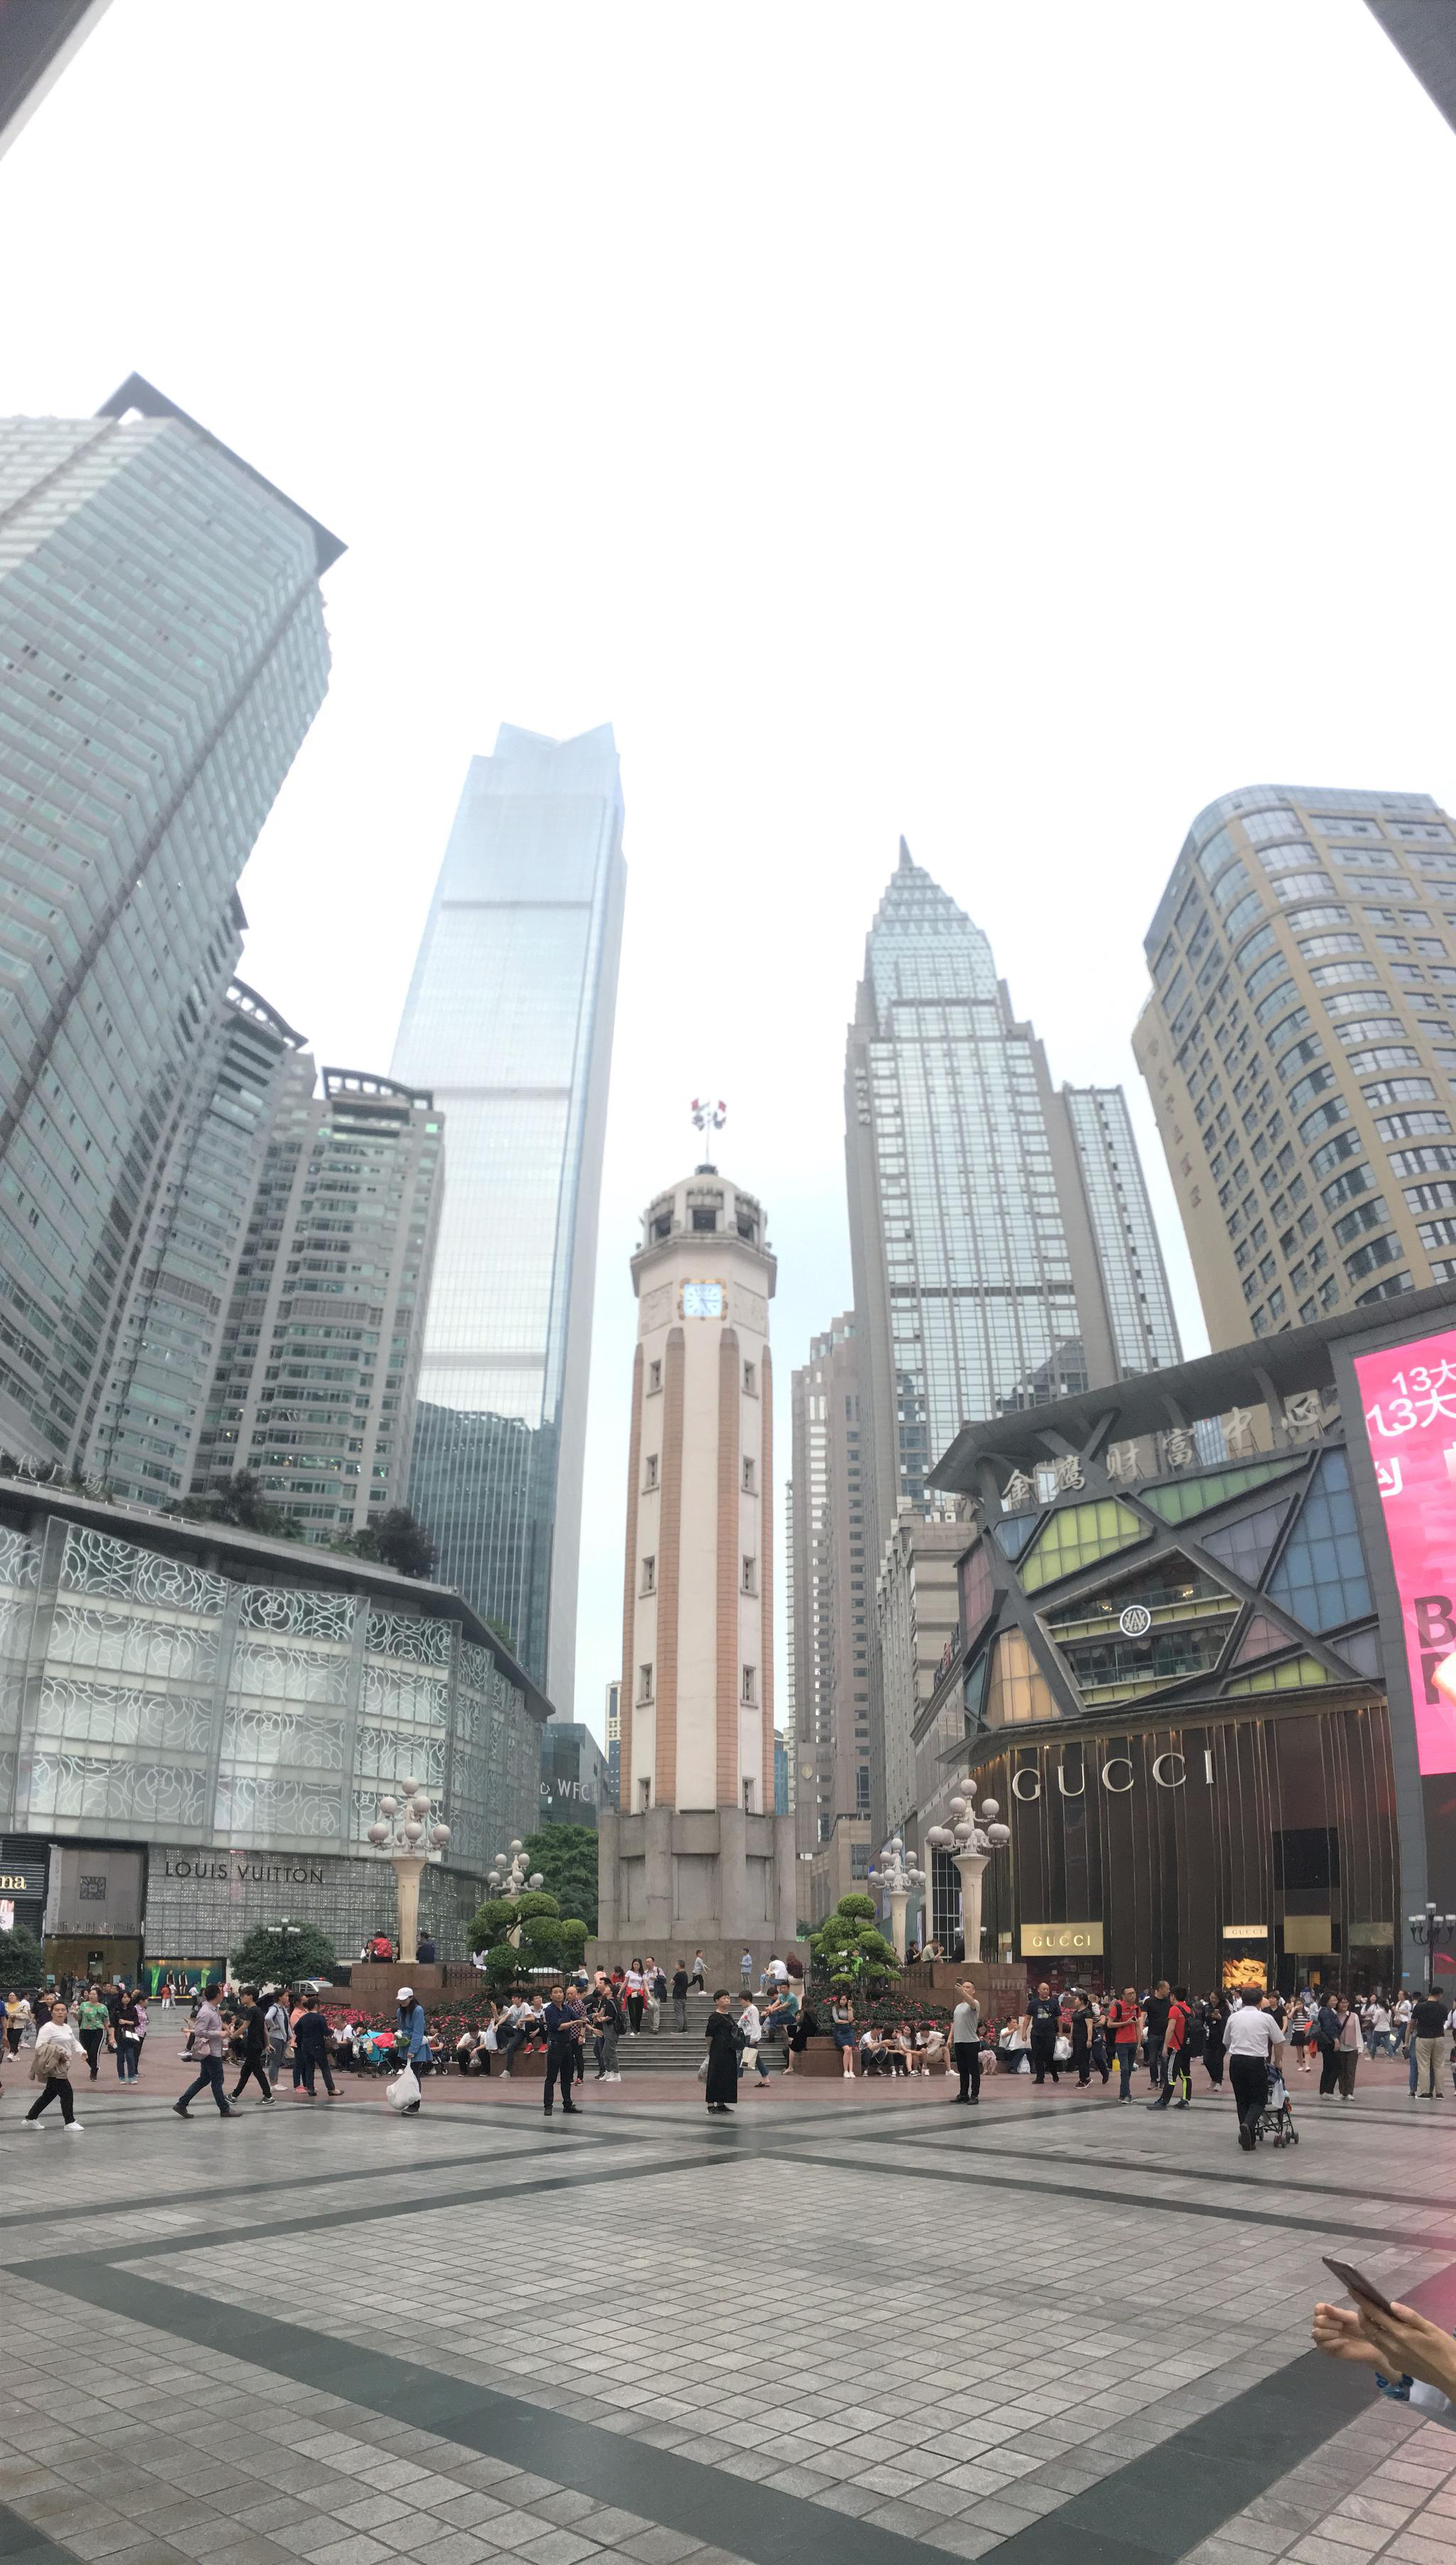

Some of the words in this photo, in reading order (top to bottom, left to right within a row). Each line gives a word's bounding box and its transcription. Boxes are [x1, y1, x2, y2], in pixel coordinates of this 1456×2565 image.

[1001, 1398, 1320, 1500] 金鹰财富中心
[0, 1447, 103, 1494] 代广场
[557, 1778, 590, 1801] WFC
[1012, 1749, 1214, 1801] GUCCI
[166, 1861, 228, 1879] LOUIS
[237, 1864, 323, 1883] VUITTON
[1032, 1935, 1091, 1947] GUCCI
